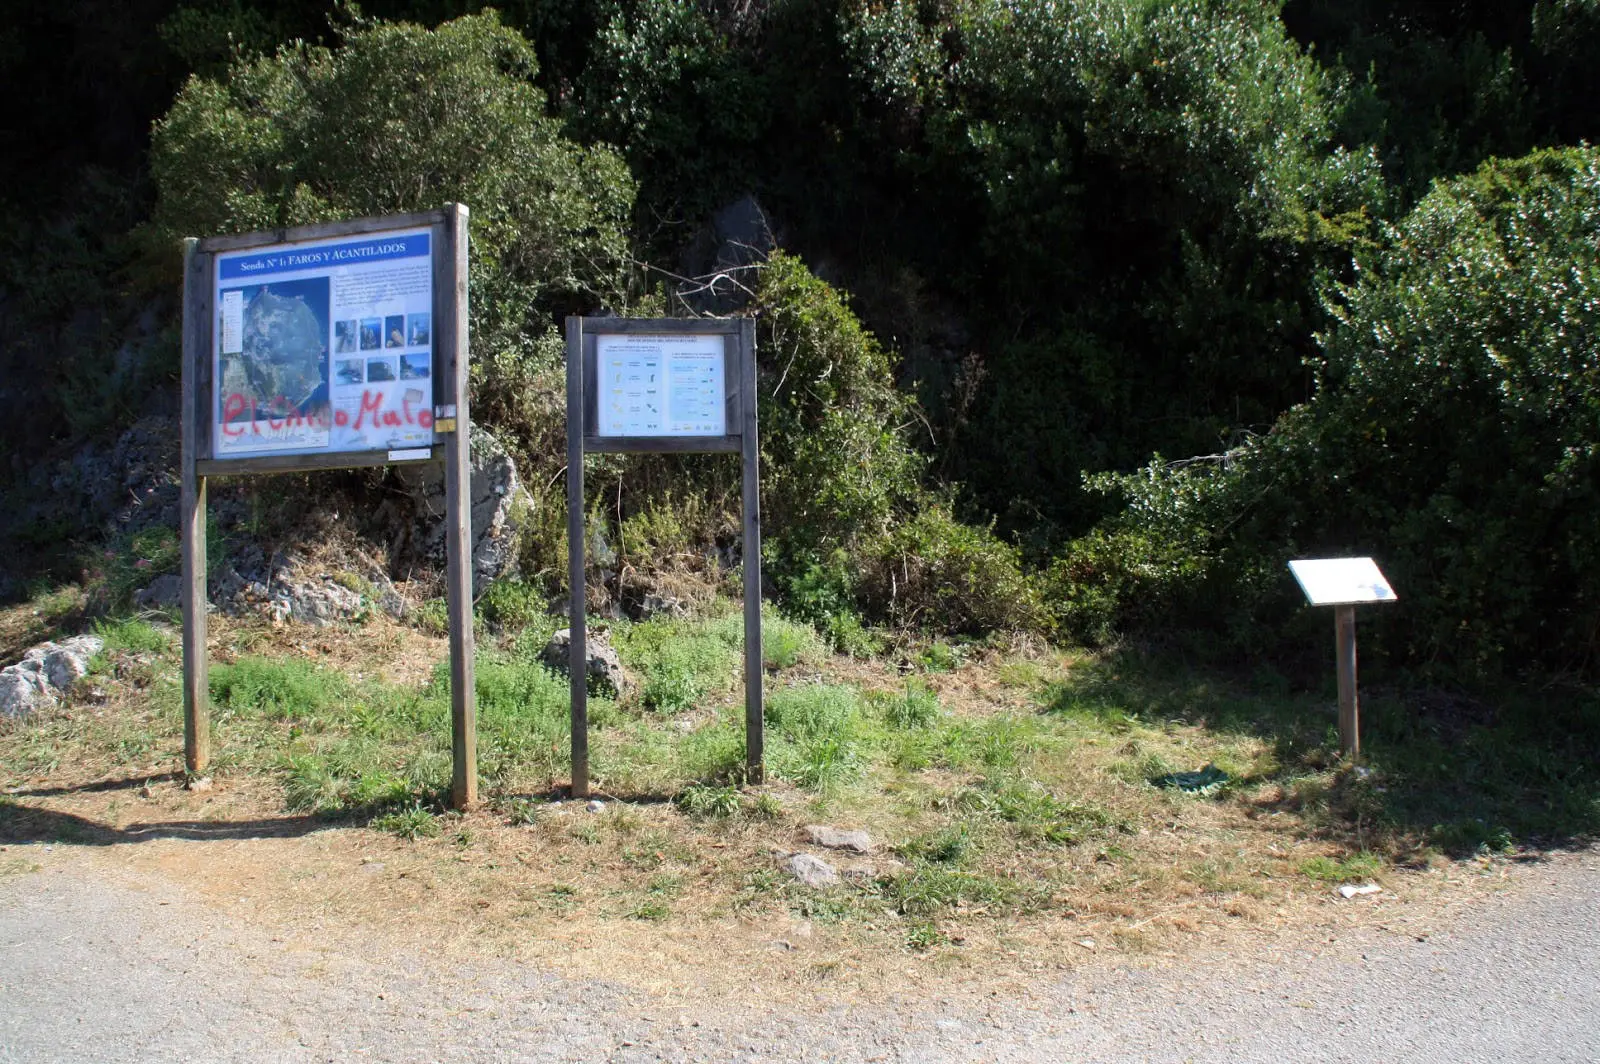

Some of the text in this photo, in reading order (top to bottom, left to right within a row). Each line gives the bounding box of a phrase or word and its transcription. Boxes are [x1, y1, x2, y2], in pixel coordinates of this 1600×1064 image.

[240, 259, 265, 271] Senda
[288, 254, 321, 265] FAROS
[323, 253, 330, 261] Y
[332, 243, 406, 260] ACANTILADOS
[352, 390, 433, 431] Malo
